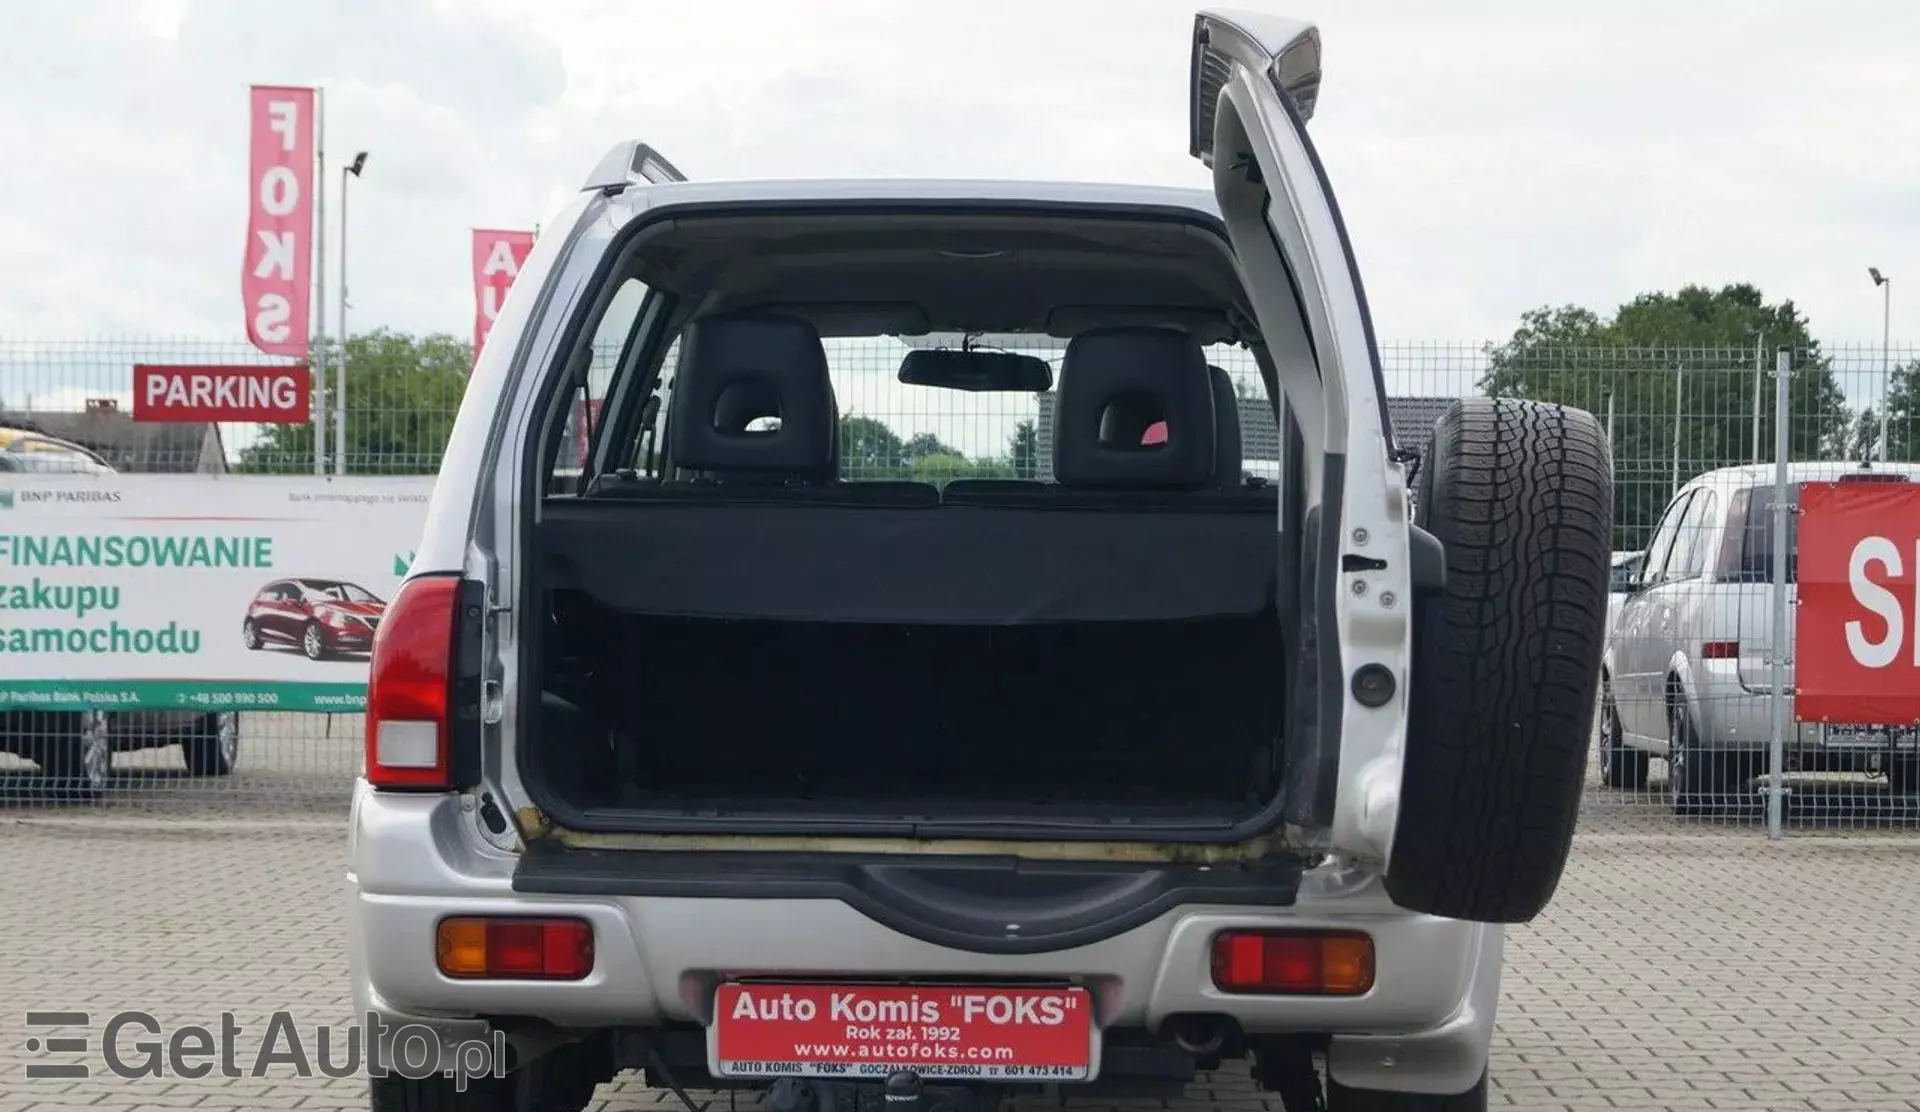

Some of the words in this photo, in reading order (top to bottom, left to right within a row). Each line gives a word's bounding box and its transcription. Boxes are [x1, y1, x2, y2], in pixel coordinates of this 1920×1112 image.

[483, 240, 518, 342] AU
[147, 375, 296, 409] PARKING
[21, 491, 52, 502] BNP
[57, 491, 121, 502] PARIBAS
[0, 536, 273, 567] FINANSOWANIE
[1845, 536, 1920, 668] S
[732, 992, 816, 1021] Auto
[831, 993, 939, 1023] Komis
[951, 996, 1077, 1025] "FOKS"
[846, 1025, 880, 1040] Rok
[885, 1026, 917, 1041] zał.
[921, 1026, 960, 1042] 1992
[794, 1043, 1014, 1060] www.autofoks.com
[731, 1061, 762, 1073] AUTO
[765, 1061, 802, 1073] KOMIS
[1004, 1065, 1025, 1076] 601
[1028, 1065, 1050, 1077] 473
[1052, 1066, 1073, 1077] 414
